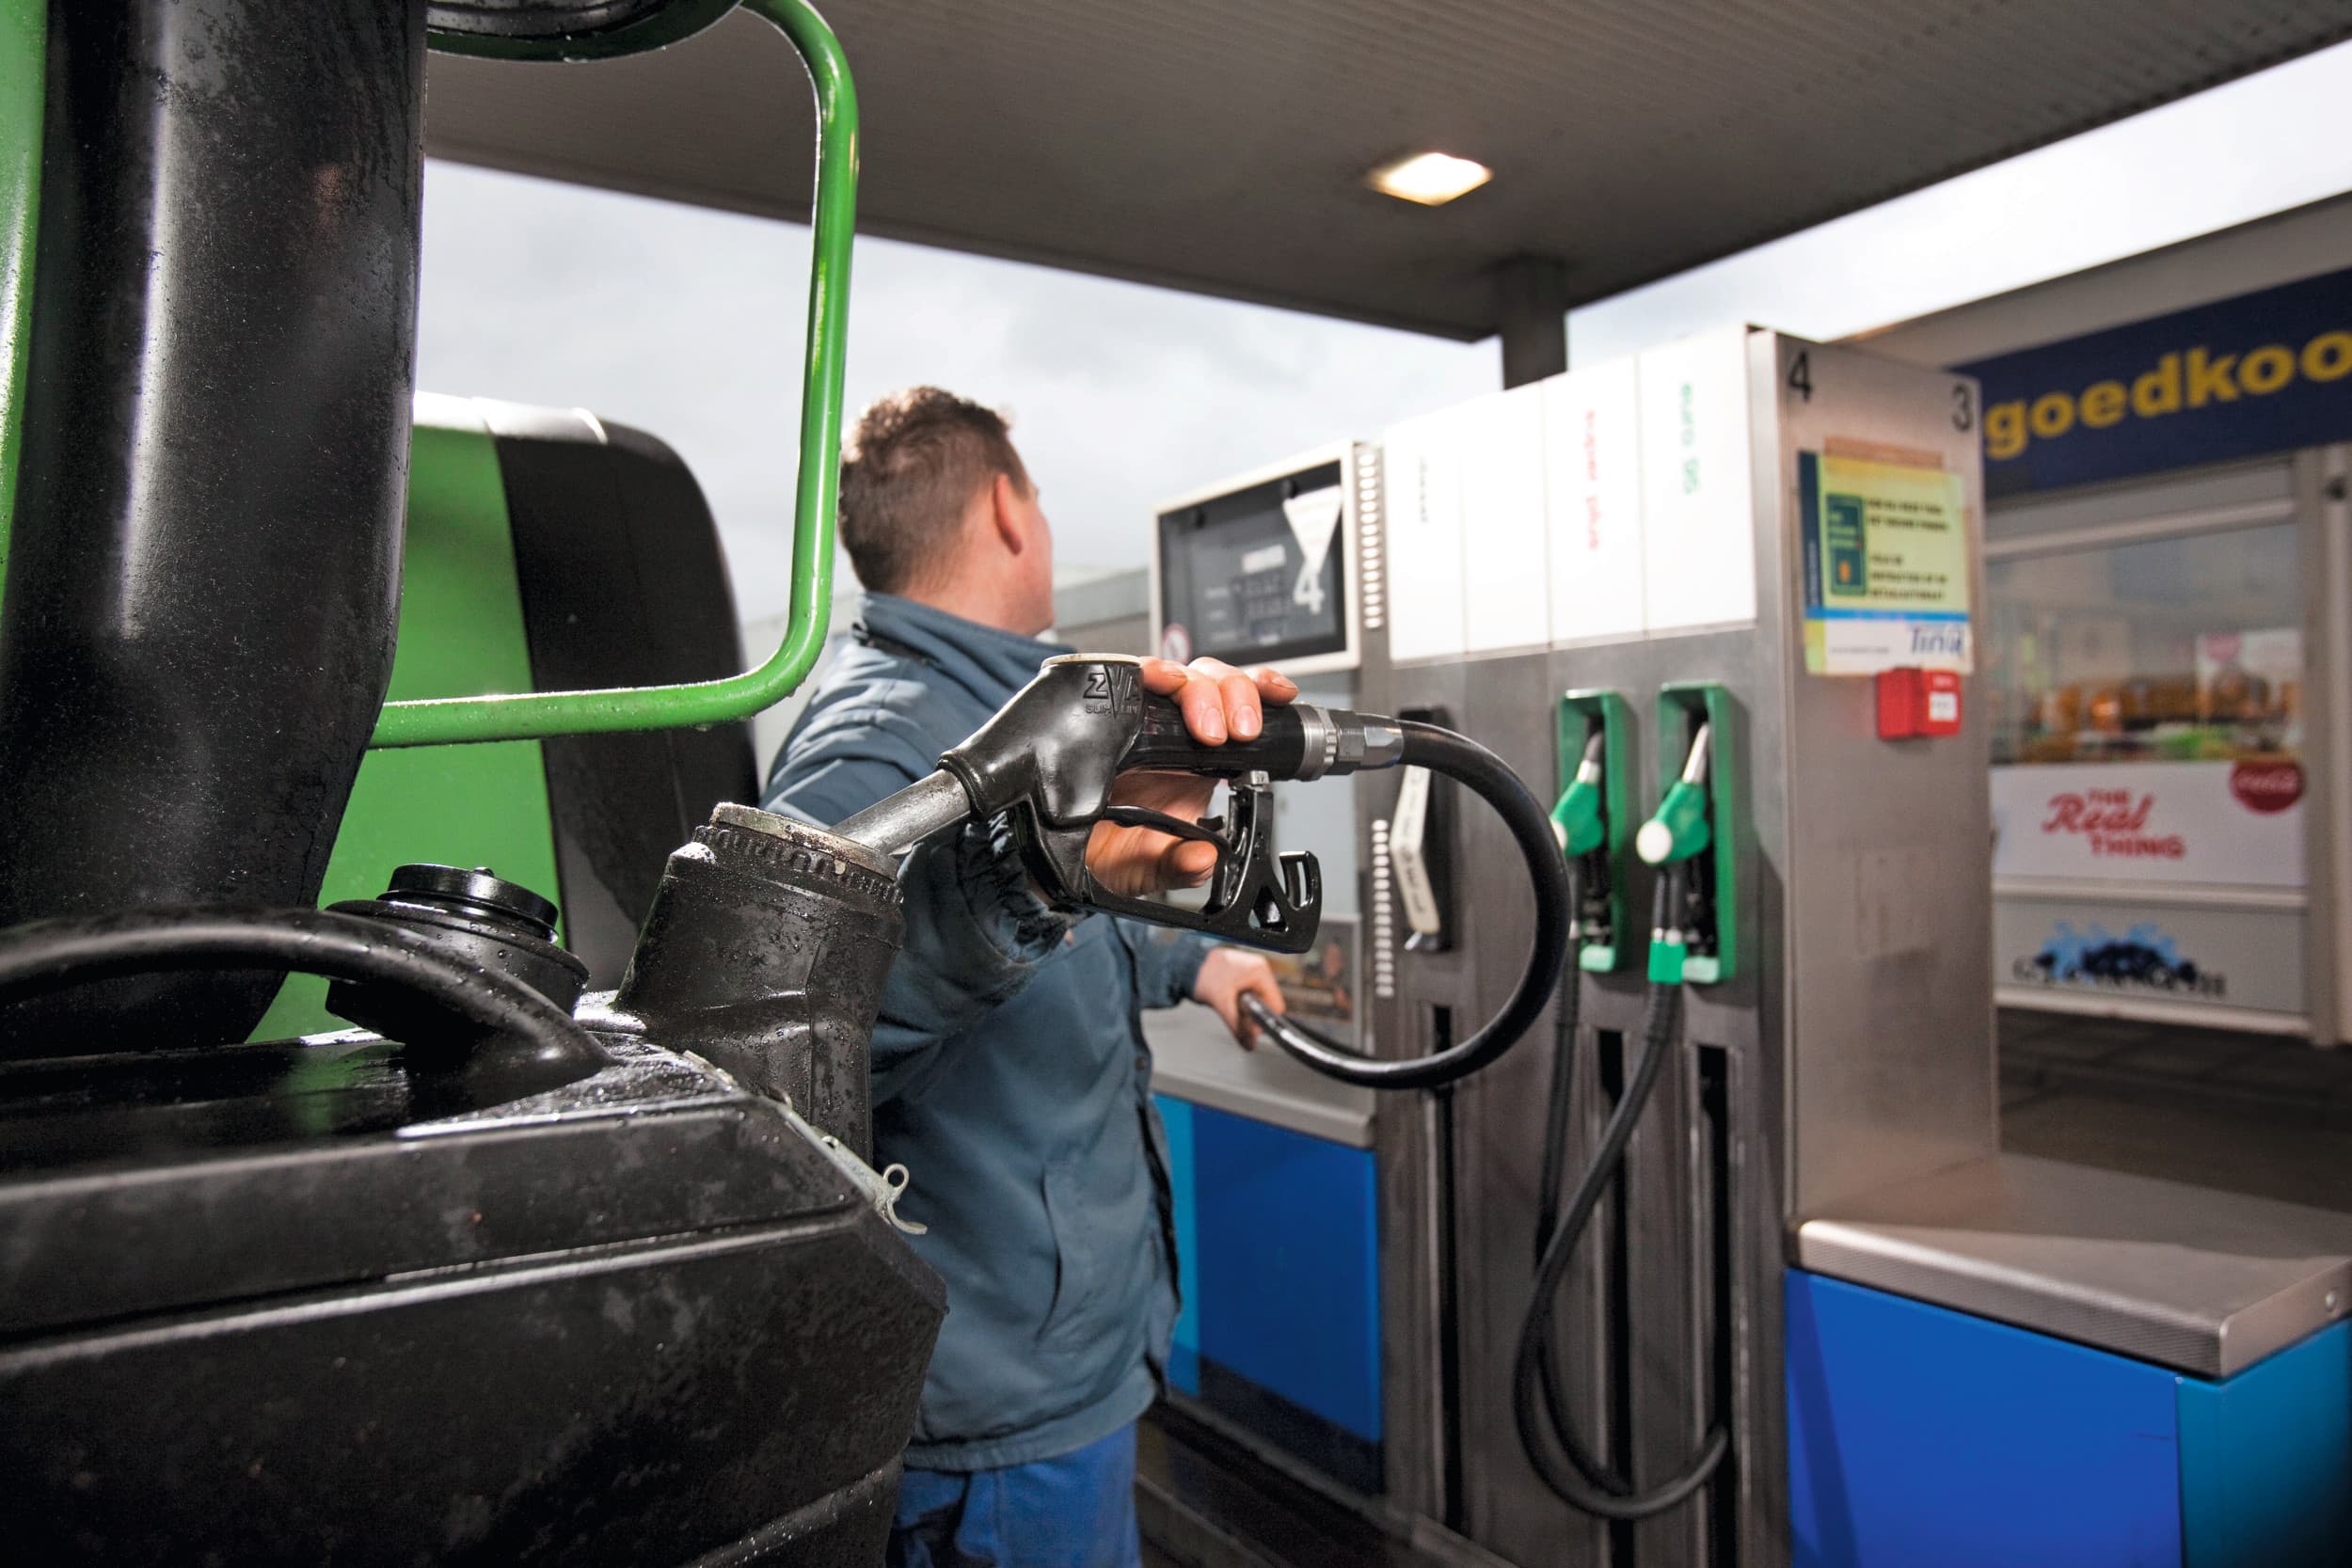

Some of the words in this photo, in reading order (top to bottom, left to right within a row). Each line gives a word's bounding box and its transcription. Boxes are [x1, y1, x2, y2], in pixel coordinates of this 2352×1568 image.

[1788, 348, 1814, 404] 4
[1983, 330, 2352, 459] goedkoo
[1951, 383, 1974, 433] 3
[1685, 457, 1700, 495] 95
[1292, 562, 1325, 615] 4
[2042, 792, 2155, 833] Real
[2087, 788, 2129, 805] THE
[2088, 835, 2185, 860] THING
